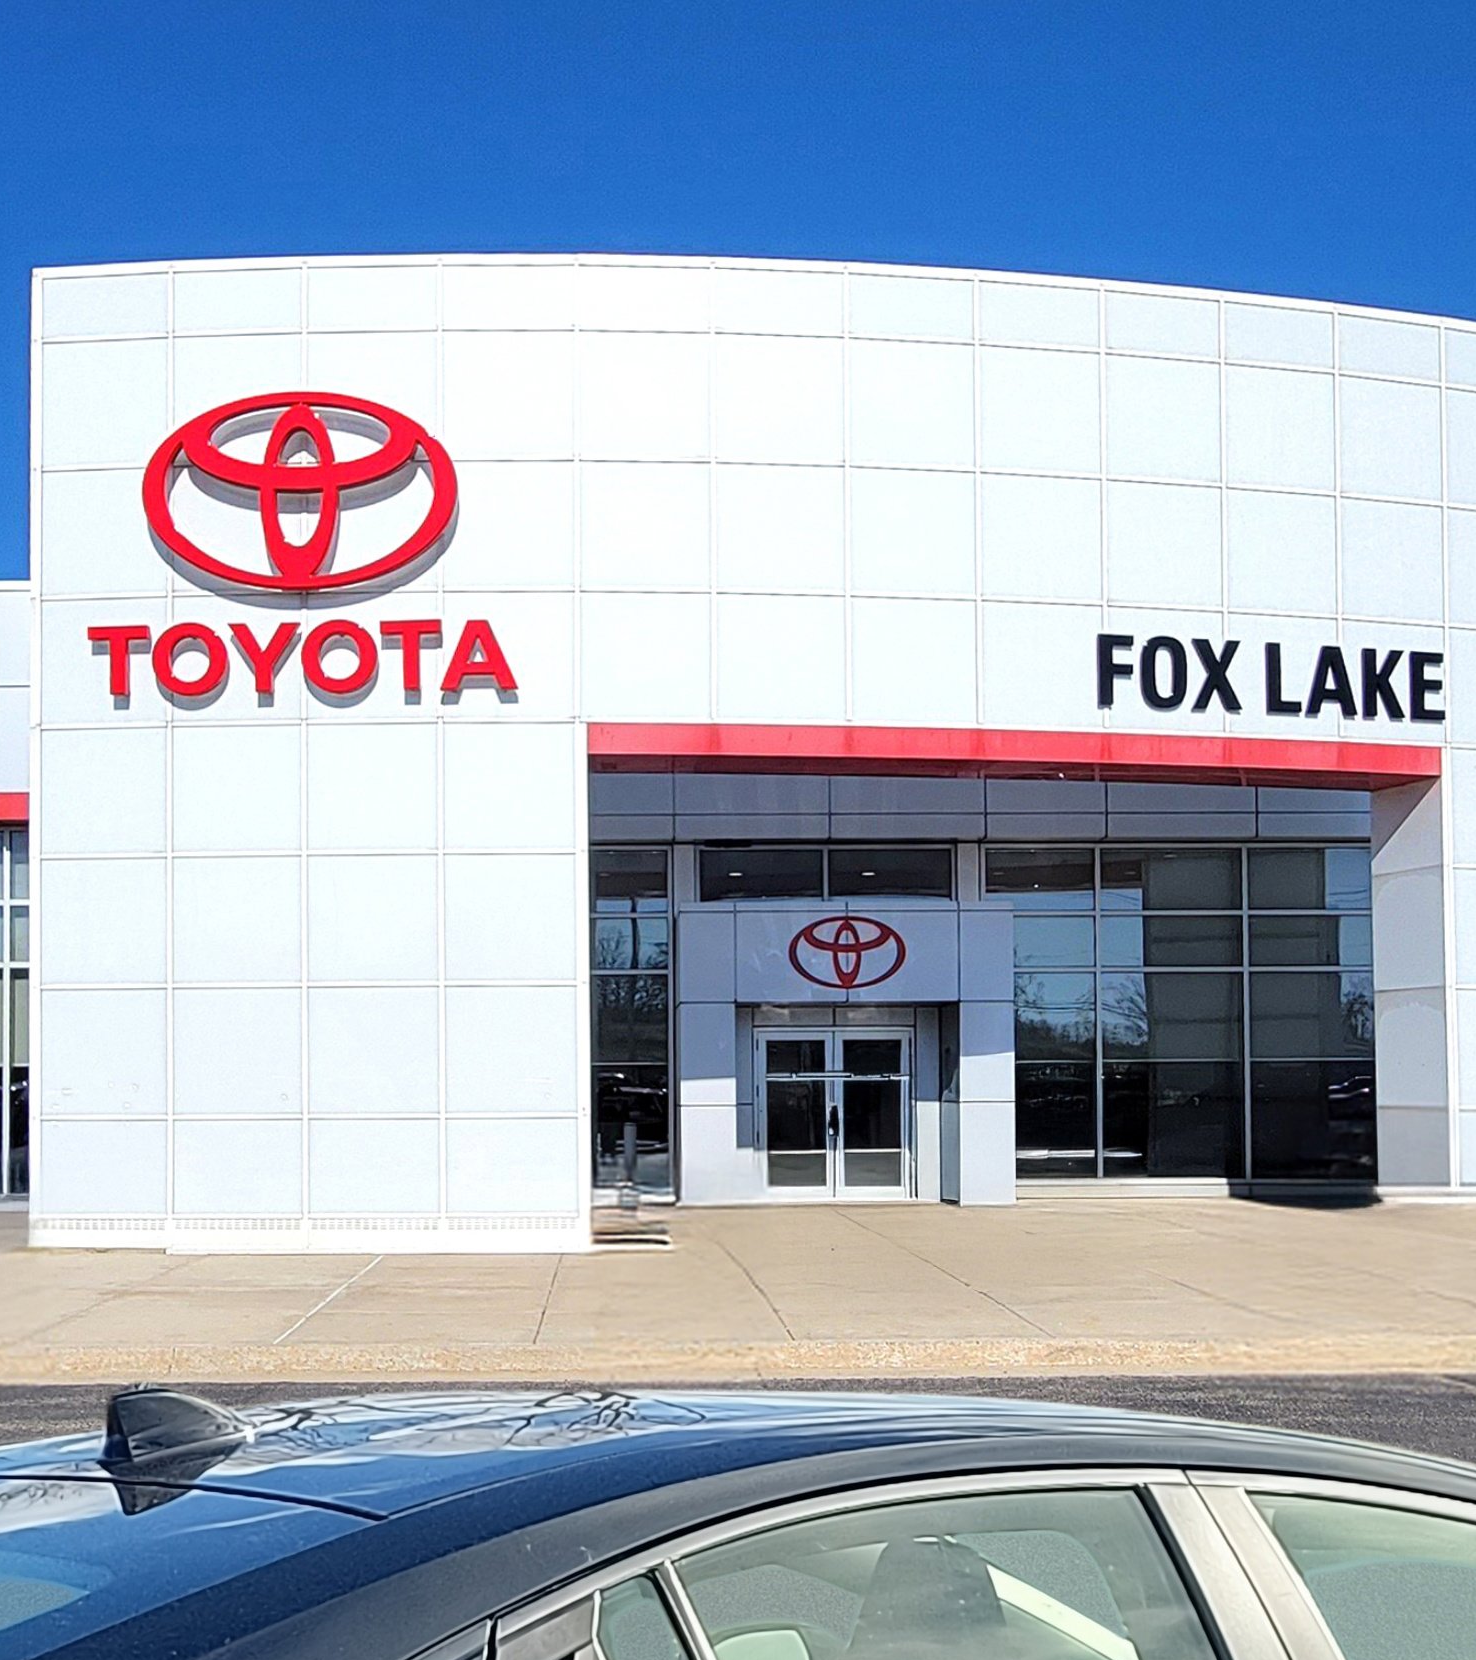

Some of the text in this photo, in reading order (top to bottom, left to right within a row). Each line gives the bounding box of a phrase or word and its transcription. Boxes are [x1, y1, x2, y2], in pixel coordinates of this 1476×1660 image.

[87, 619, 518, 698] TOYOTA
[1097, 633, 1446, 721] FOX LAKE
